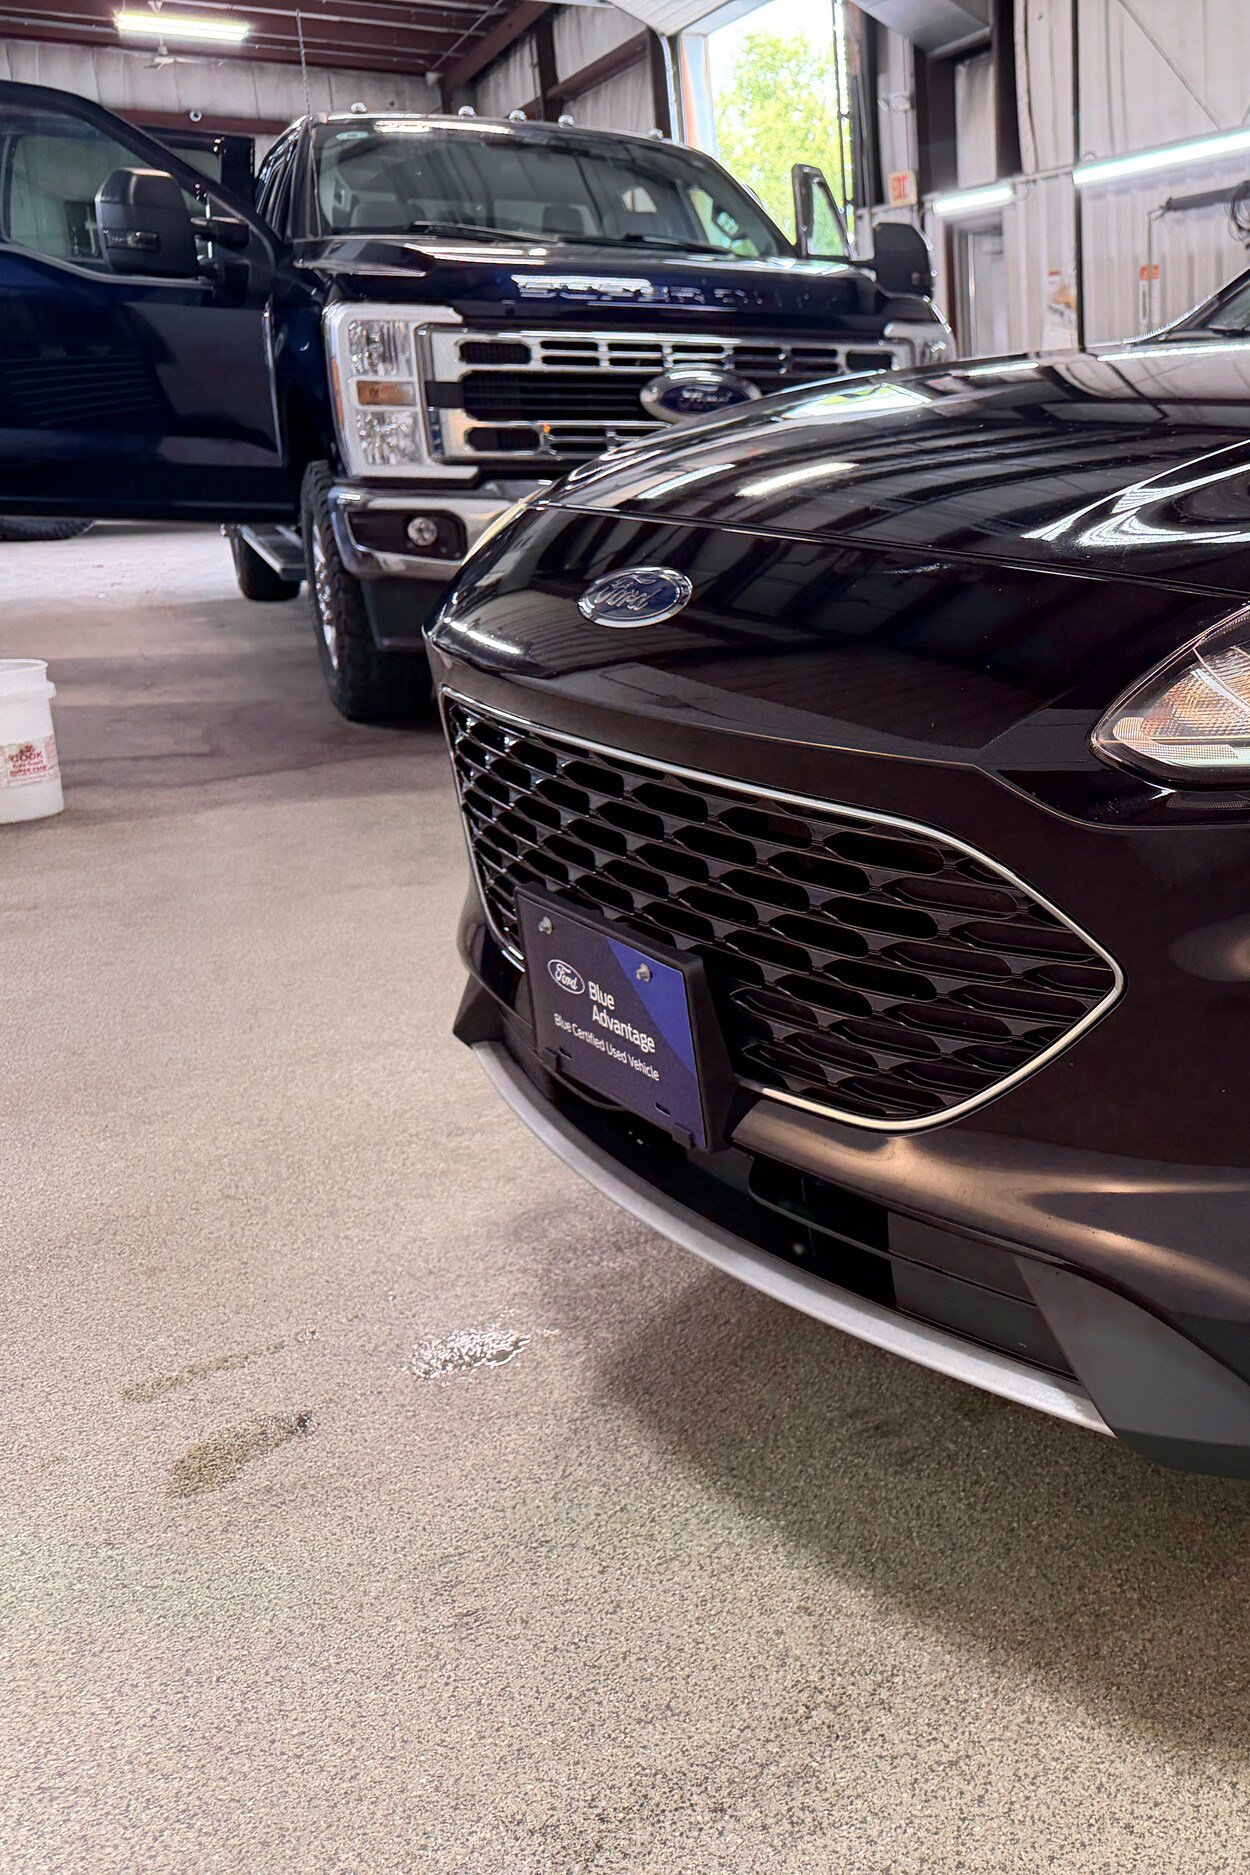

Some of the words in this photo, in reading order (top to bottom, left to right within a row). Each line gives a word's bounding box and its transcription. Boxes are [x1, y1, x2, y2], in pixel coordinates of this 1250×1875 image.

[593, 574, 664, 612] Ford
[555, 963, 579, 990] Ford
[588, 980, 615, 1010] Blue
[554, 1012, 572, 1033] Blue
[572, 1023, 606, 1052] Certified
[606, 1041, 628, 1064] Used
[627, 1053, 660, 1082] Vehicle
[592, 1004, 656, 1053] Advantage
